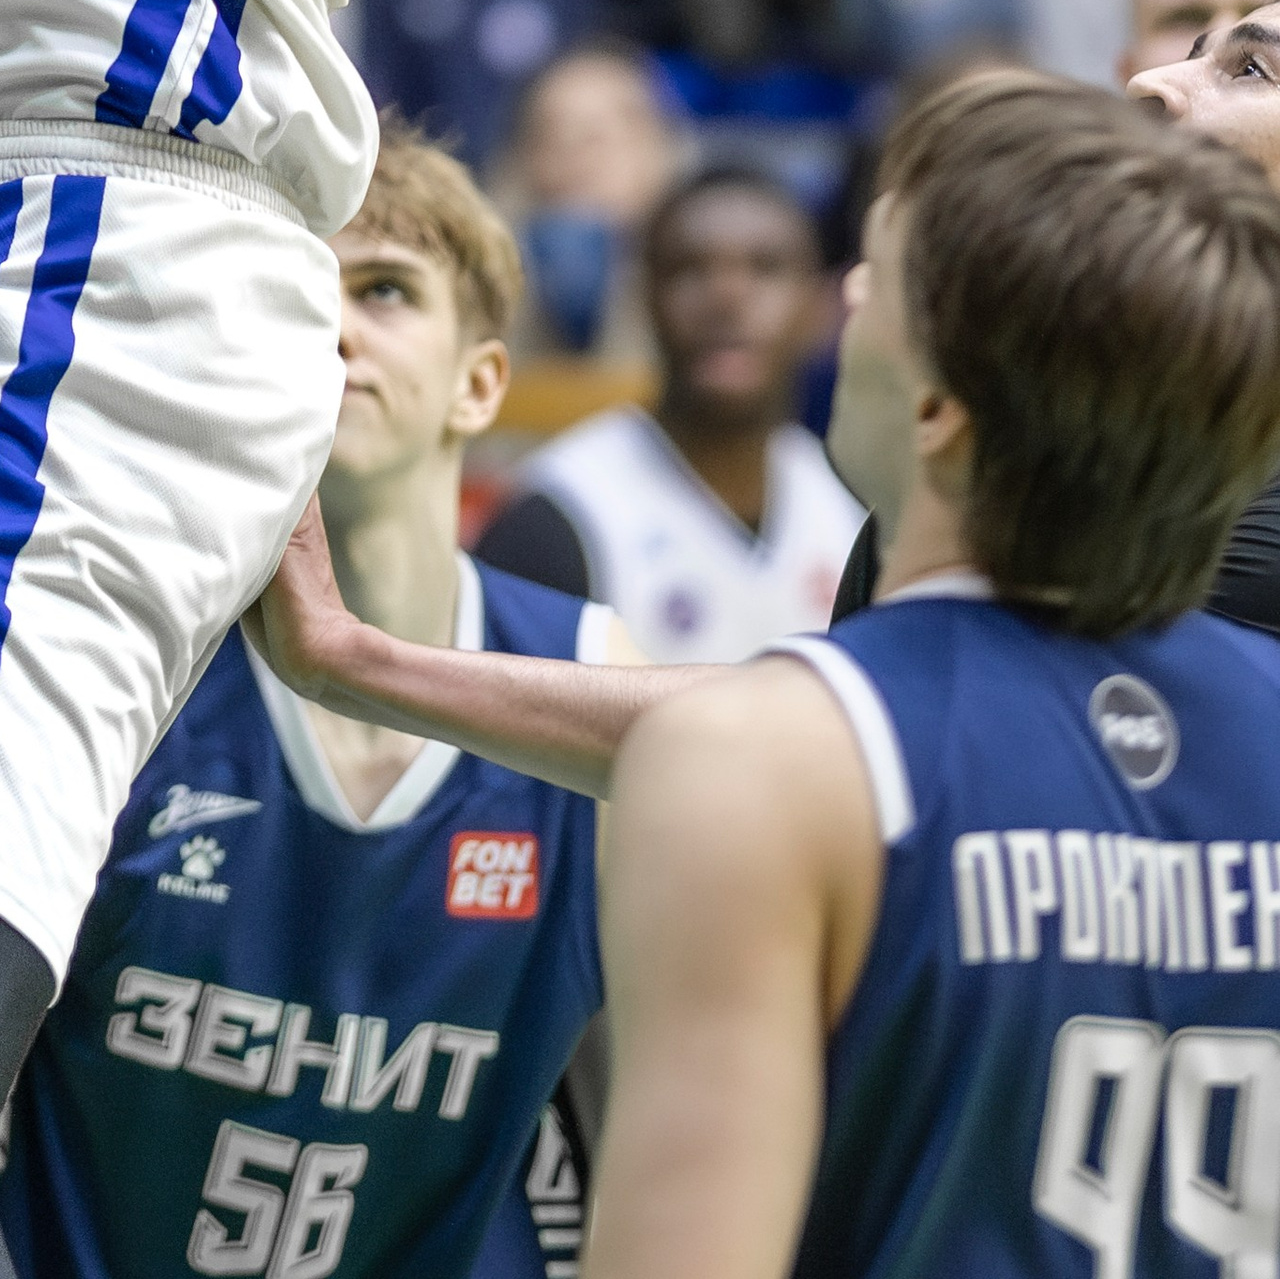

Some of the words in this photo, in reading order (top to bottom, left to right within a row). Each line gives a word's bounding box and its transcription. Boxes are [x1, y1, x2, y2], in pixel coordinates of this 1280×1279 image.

[449, 871, 535, 909] BET
[452, 838, 535, 873] FON
[104, 965, 501, 1121] ЗЕНИТ
[184, 1117, 370, 1279] 56
[1032, 1013, 1280, 1279] 99
